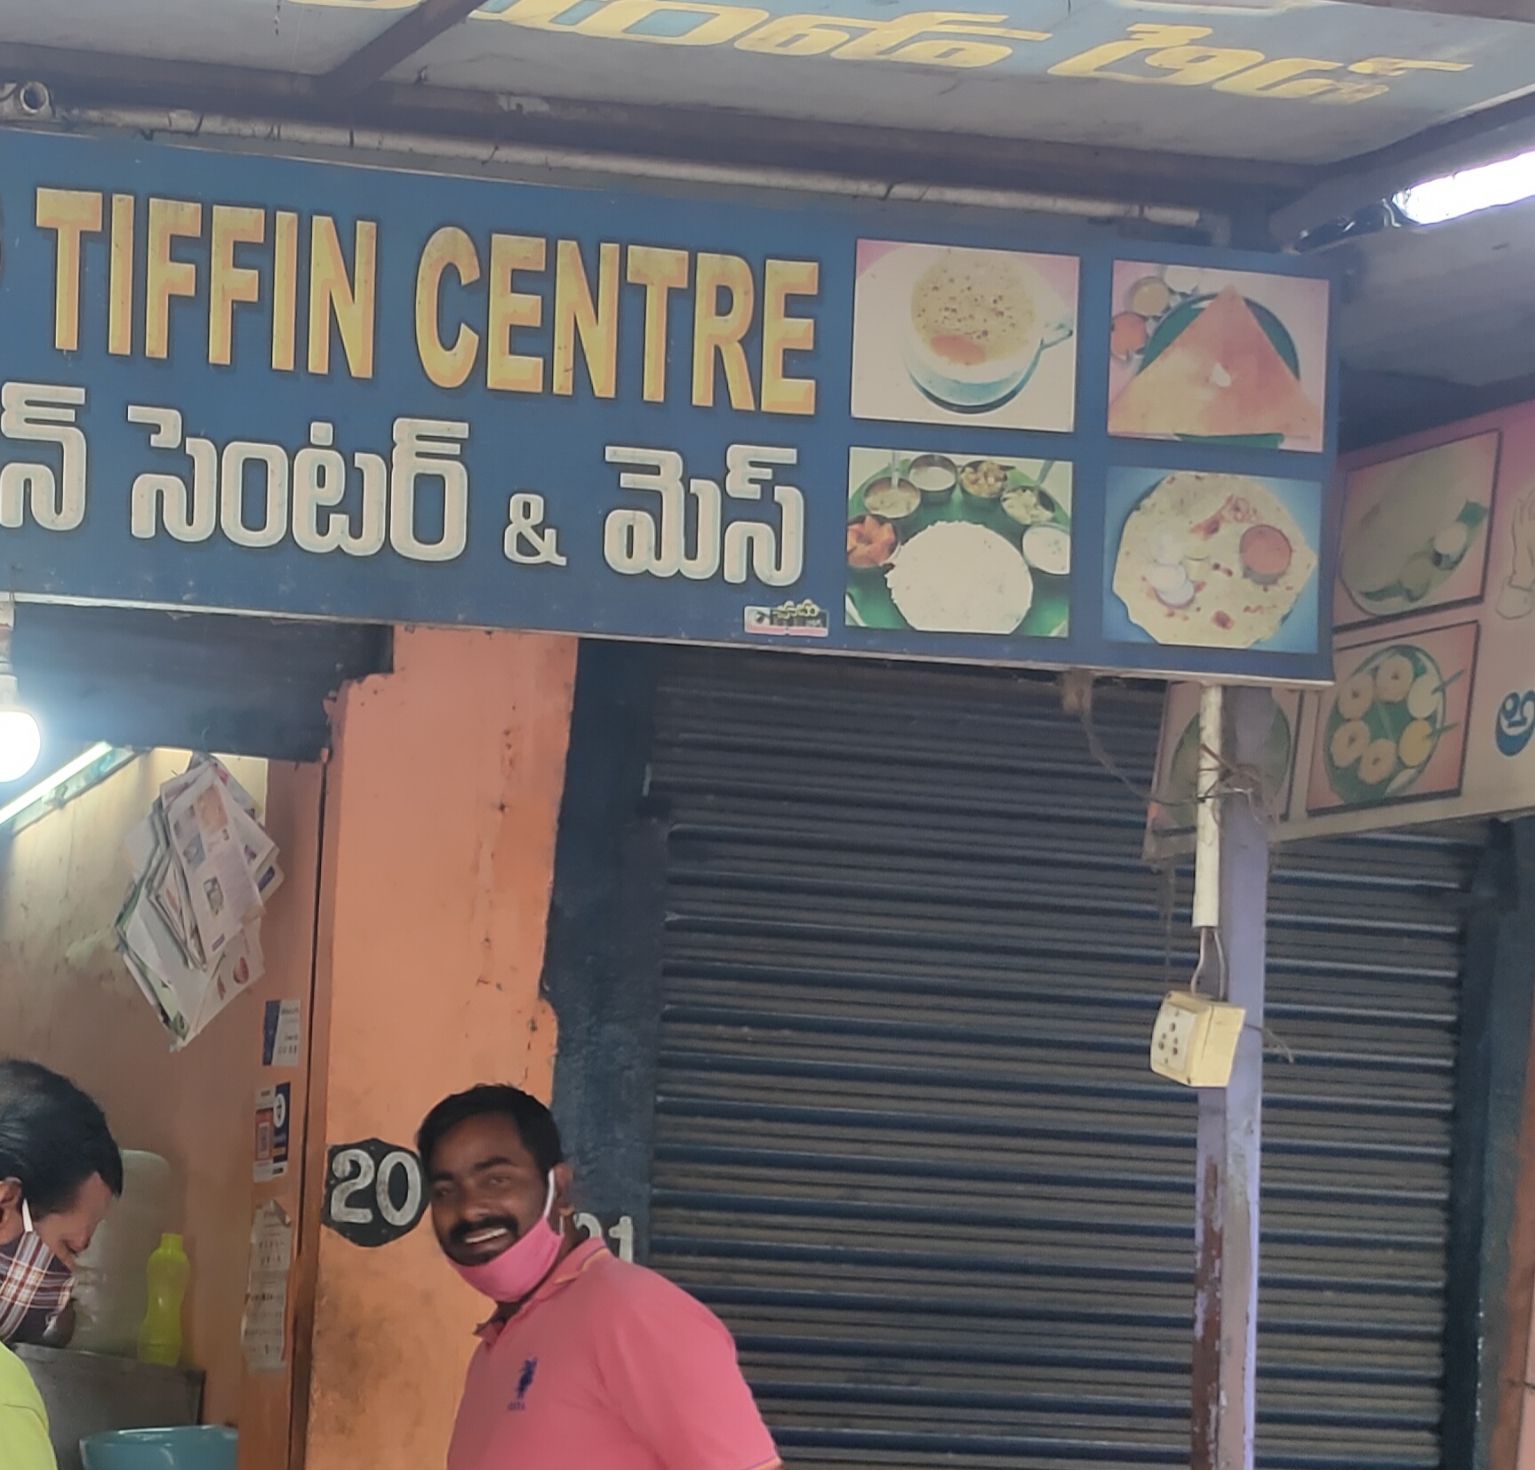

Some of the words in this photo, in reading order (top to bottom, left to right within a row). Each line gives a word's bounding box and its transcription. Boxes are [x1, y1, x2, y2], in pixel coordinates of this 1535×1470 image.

[35, 186, 378, 380] TIFFIN
[414, 225, 820, 416] CENTRE
[126, 404, 471, 562] సెంటర్
[503, 491, 569, 568] &
[604, 443, 807, 588] మెస్
[330, 1148, 422, 1227] 20
